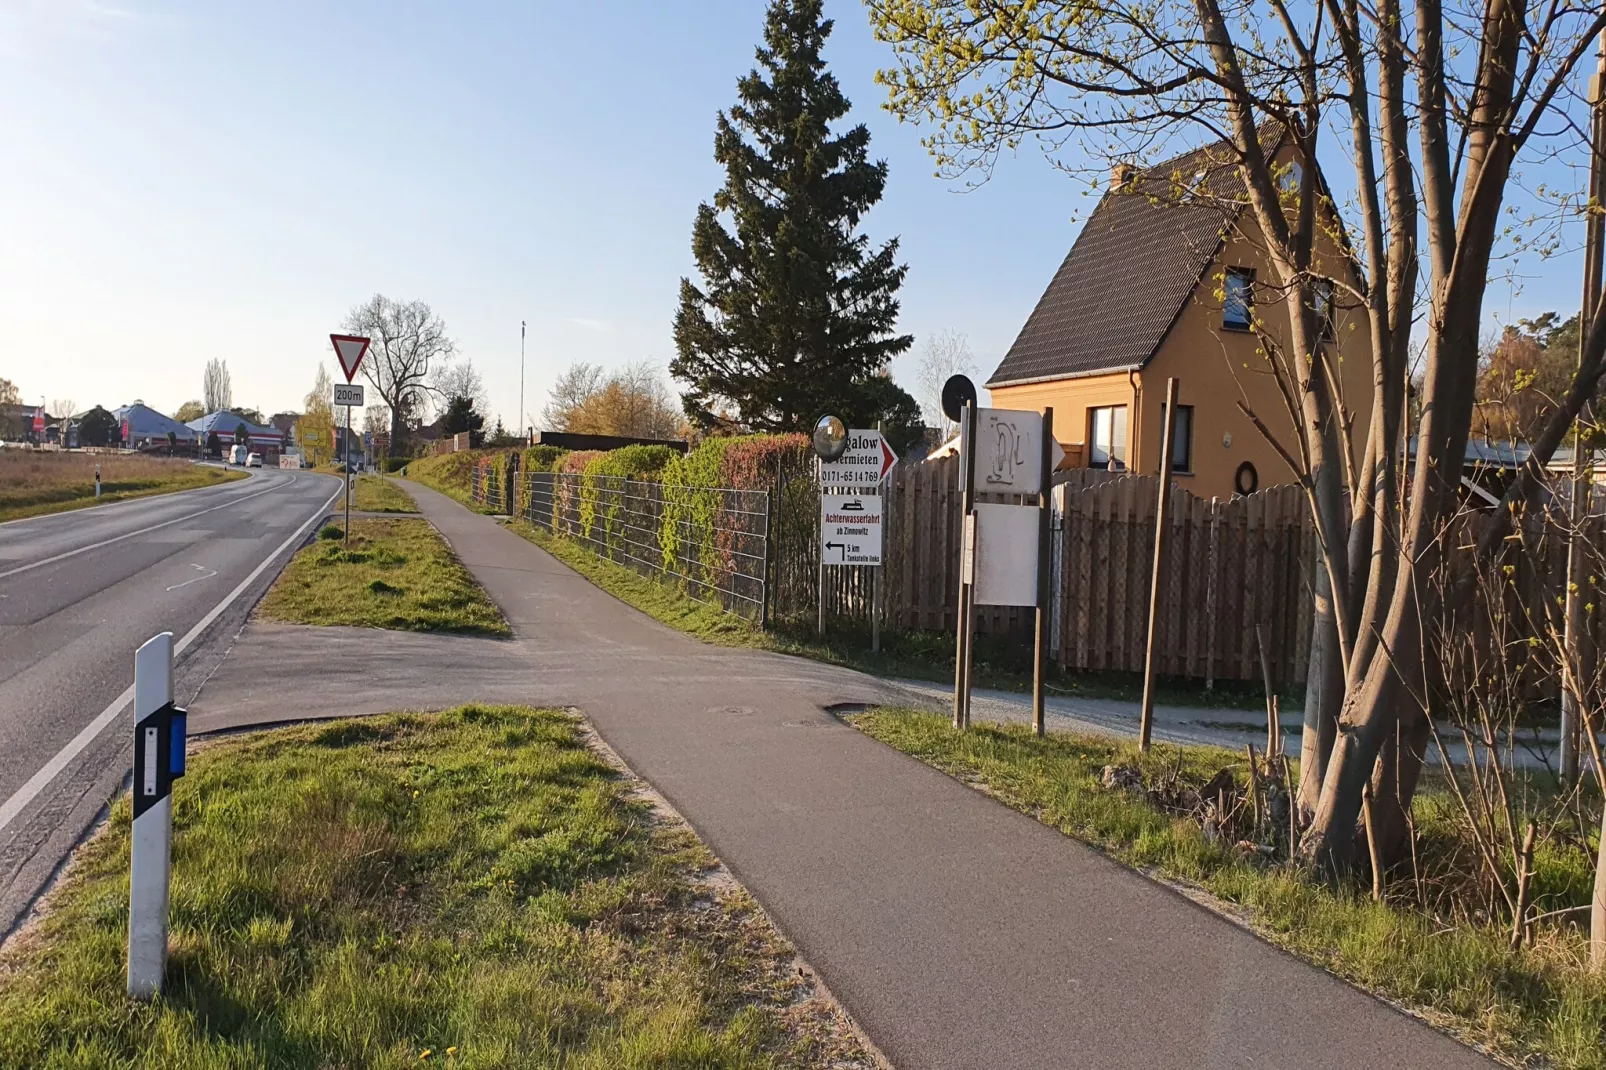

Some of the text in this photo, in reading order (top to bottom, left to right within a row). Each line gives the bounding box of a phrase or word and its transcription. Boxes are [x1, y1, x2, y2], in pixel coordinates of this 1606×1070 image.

[337, 389, 361, 401] 200m
[846, 435, 878, 452] galow
[822, 471, 878, 482] 0171-65 14 769
[825, 513, 880, 524] Achterwasserfahrt
[836, 527, 869, 536] ab Zinnowitz
[847, 544, 860, 552] 5 km
